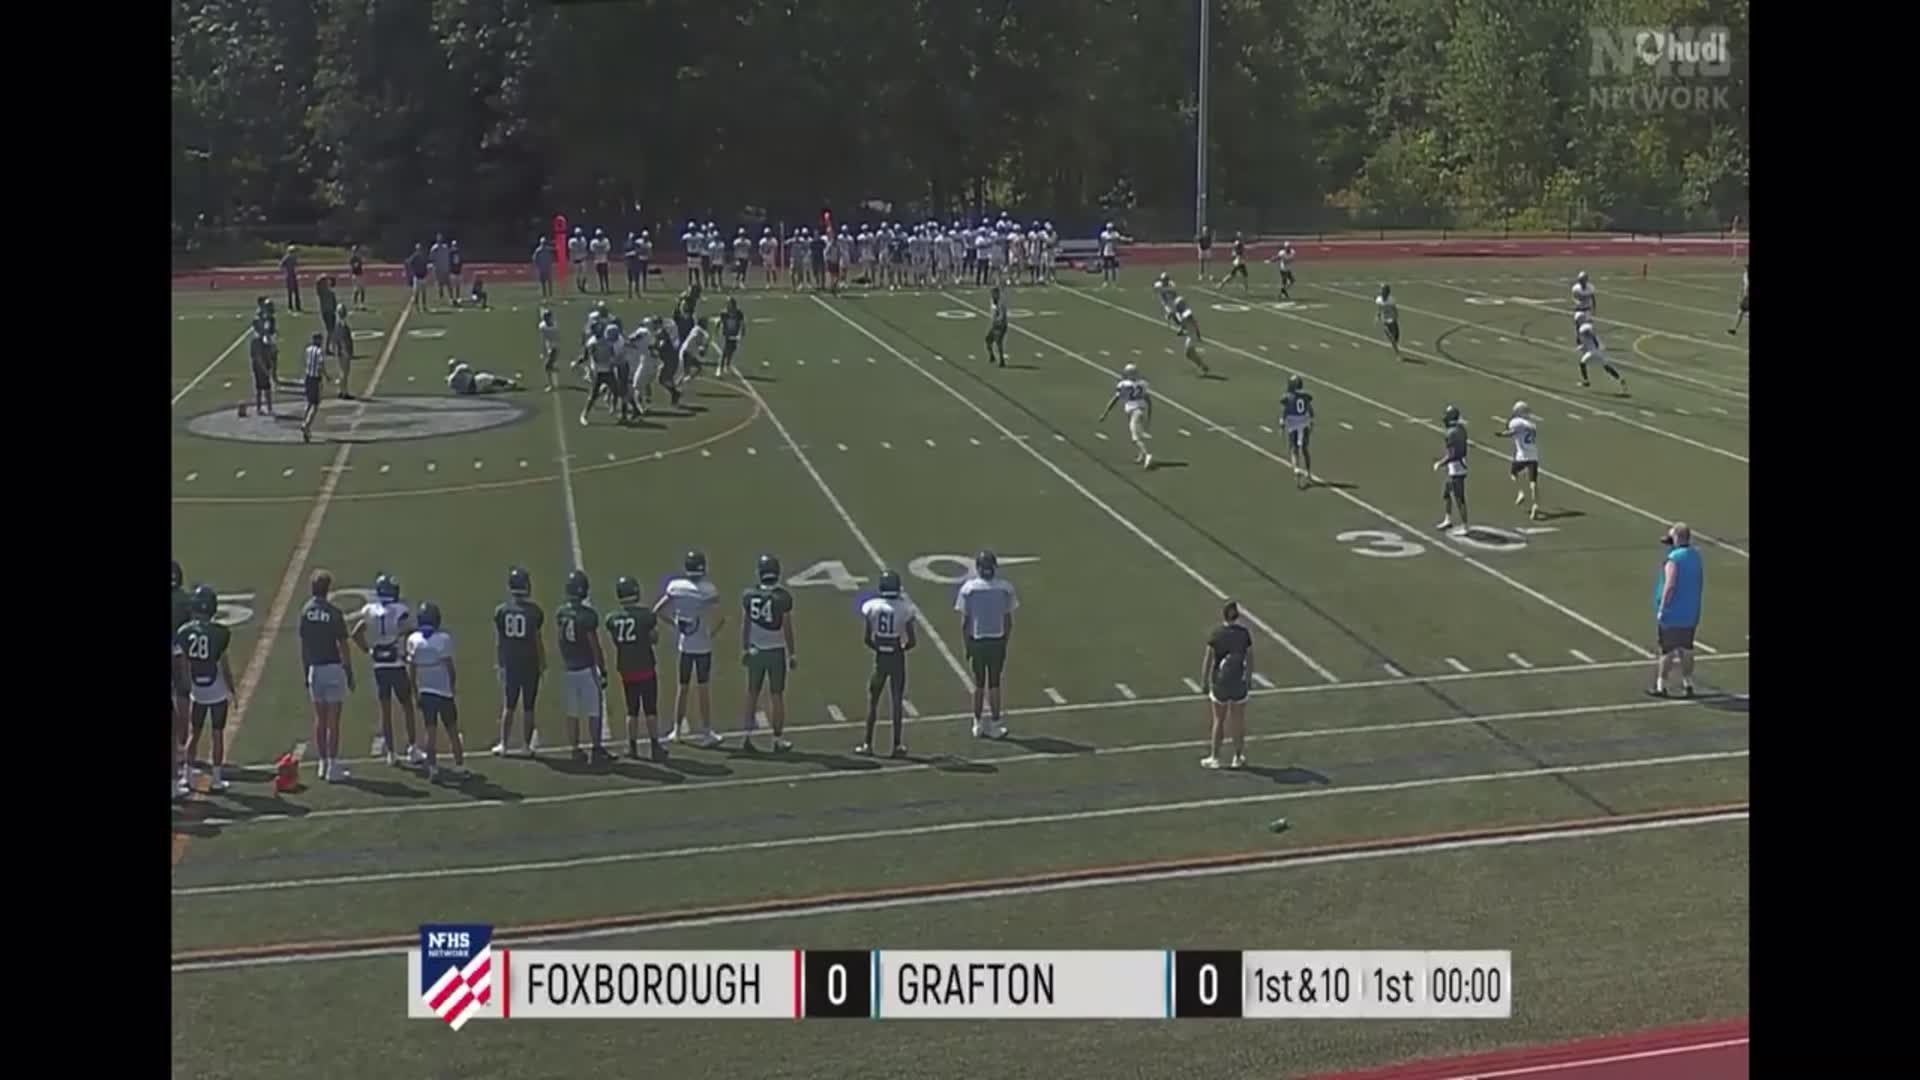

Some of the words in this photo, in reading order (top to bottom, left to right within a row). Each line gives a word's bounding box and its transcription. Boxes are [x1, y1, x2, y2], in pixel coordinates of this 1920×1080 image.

[1296, 399, 1305, 414] 0
[750, 598, 773, 622] 54
[614, 618, 637, 641] 72
[878, 611, 894, 634] 61
[187, 633, 209, 659] 28
